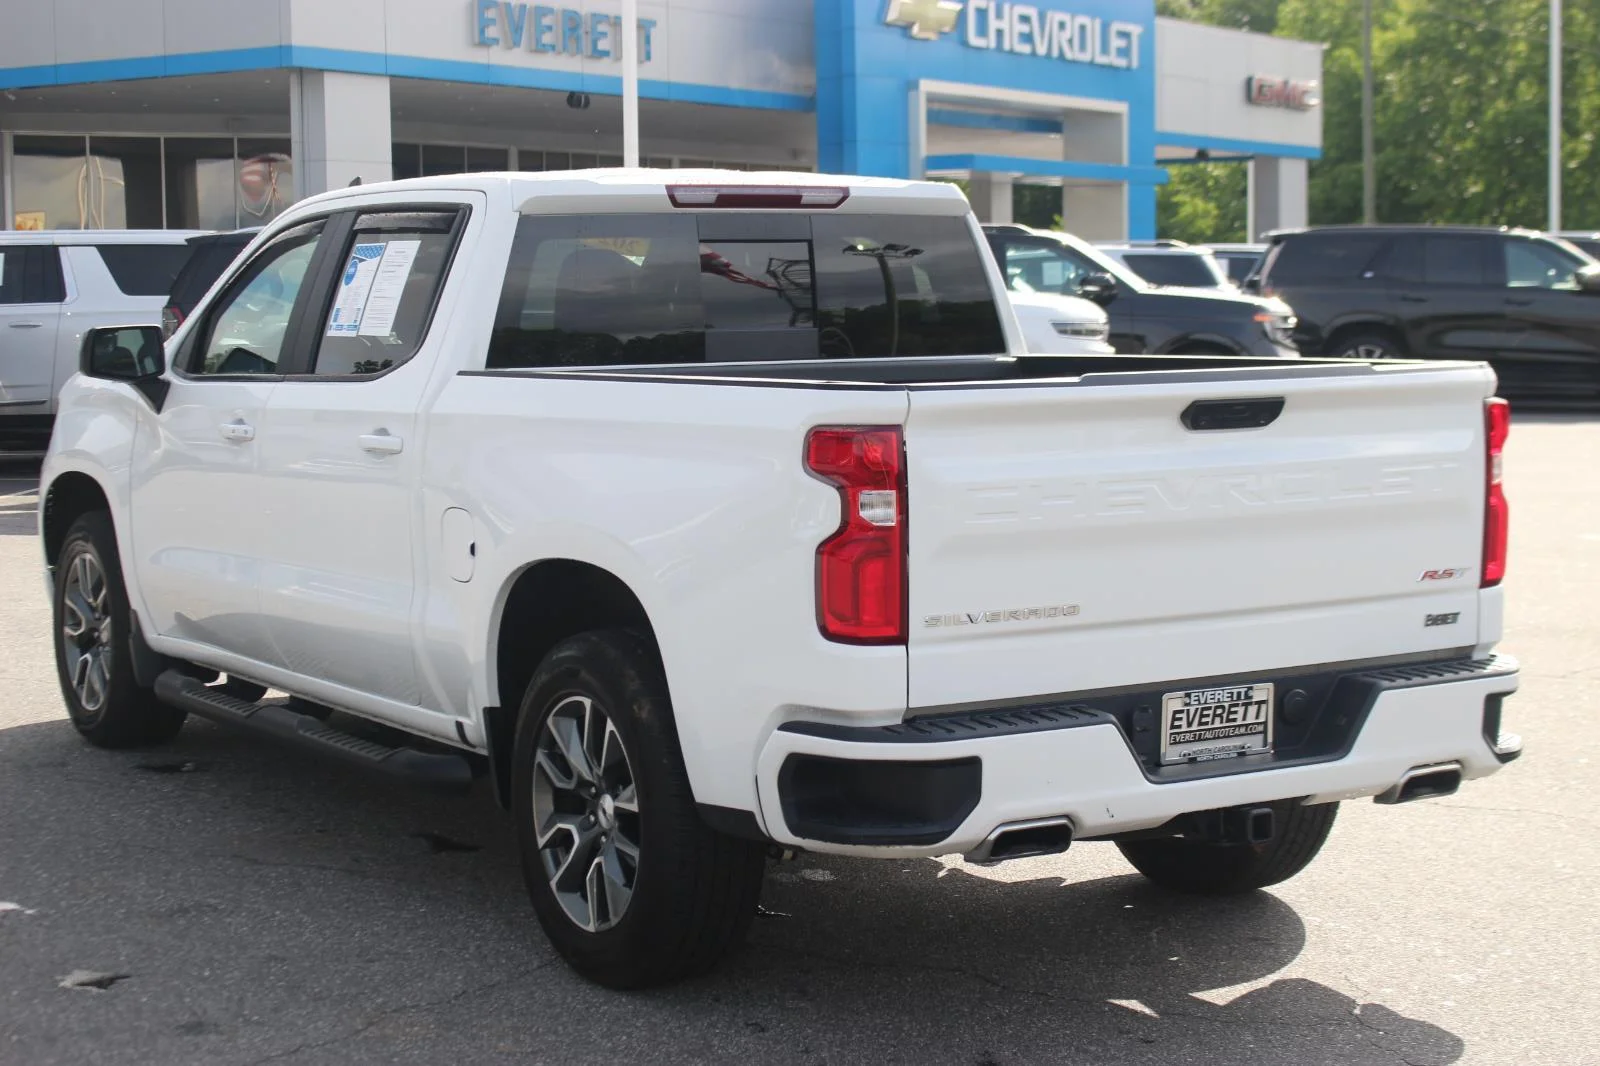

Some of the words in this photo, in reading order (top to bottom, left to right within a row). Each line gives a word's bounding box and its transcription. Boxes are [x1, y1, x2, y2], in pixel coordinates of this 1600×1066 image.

[966, 0, 1143, 69] CHEVROLET
[1247, 75, 1321, 110] GMC
[924, 604, 1080, 628] SILVERADO
[1190, 688, 1248, 704] EVERETT
[1169, 700, 1267, 730] EVERETT
[1169, 724, 1265, 744] EVERETTAUTOTEAM.COM
